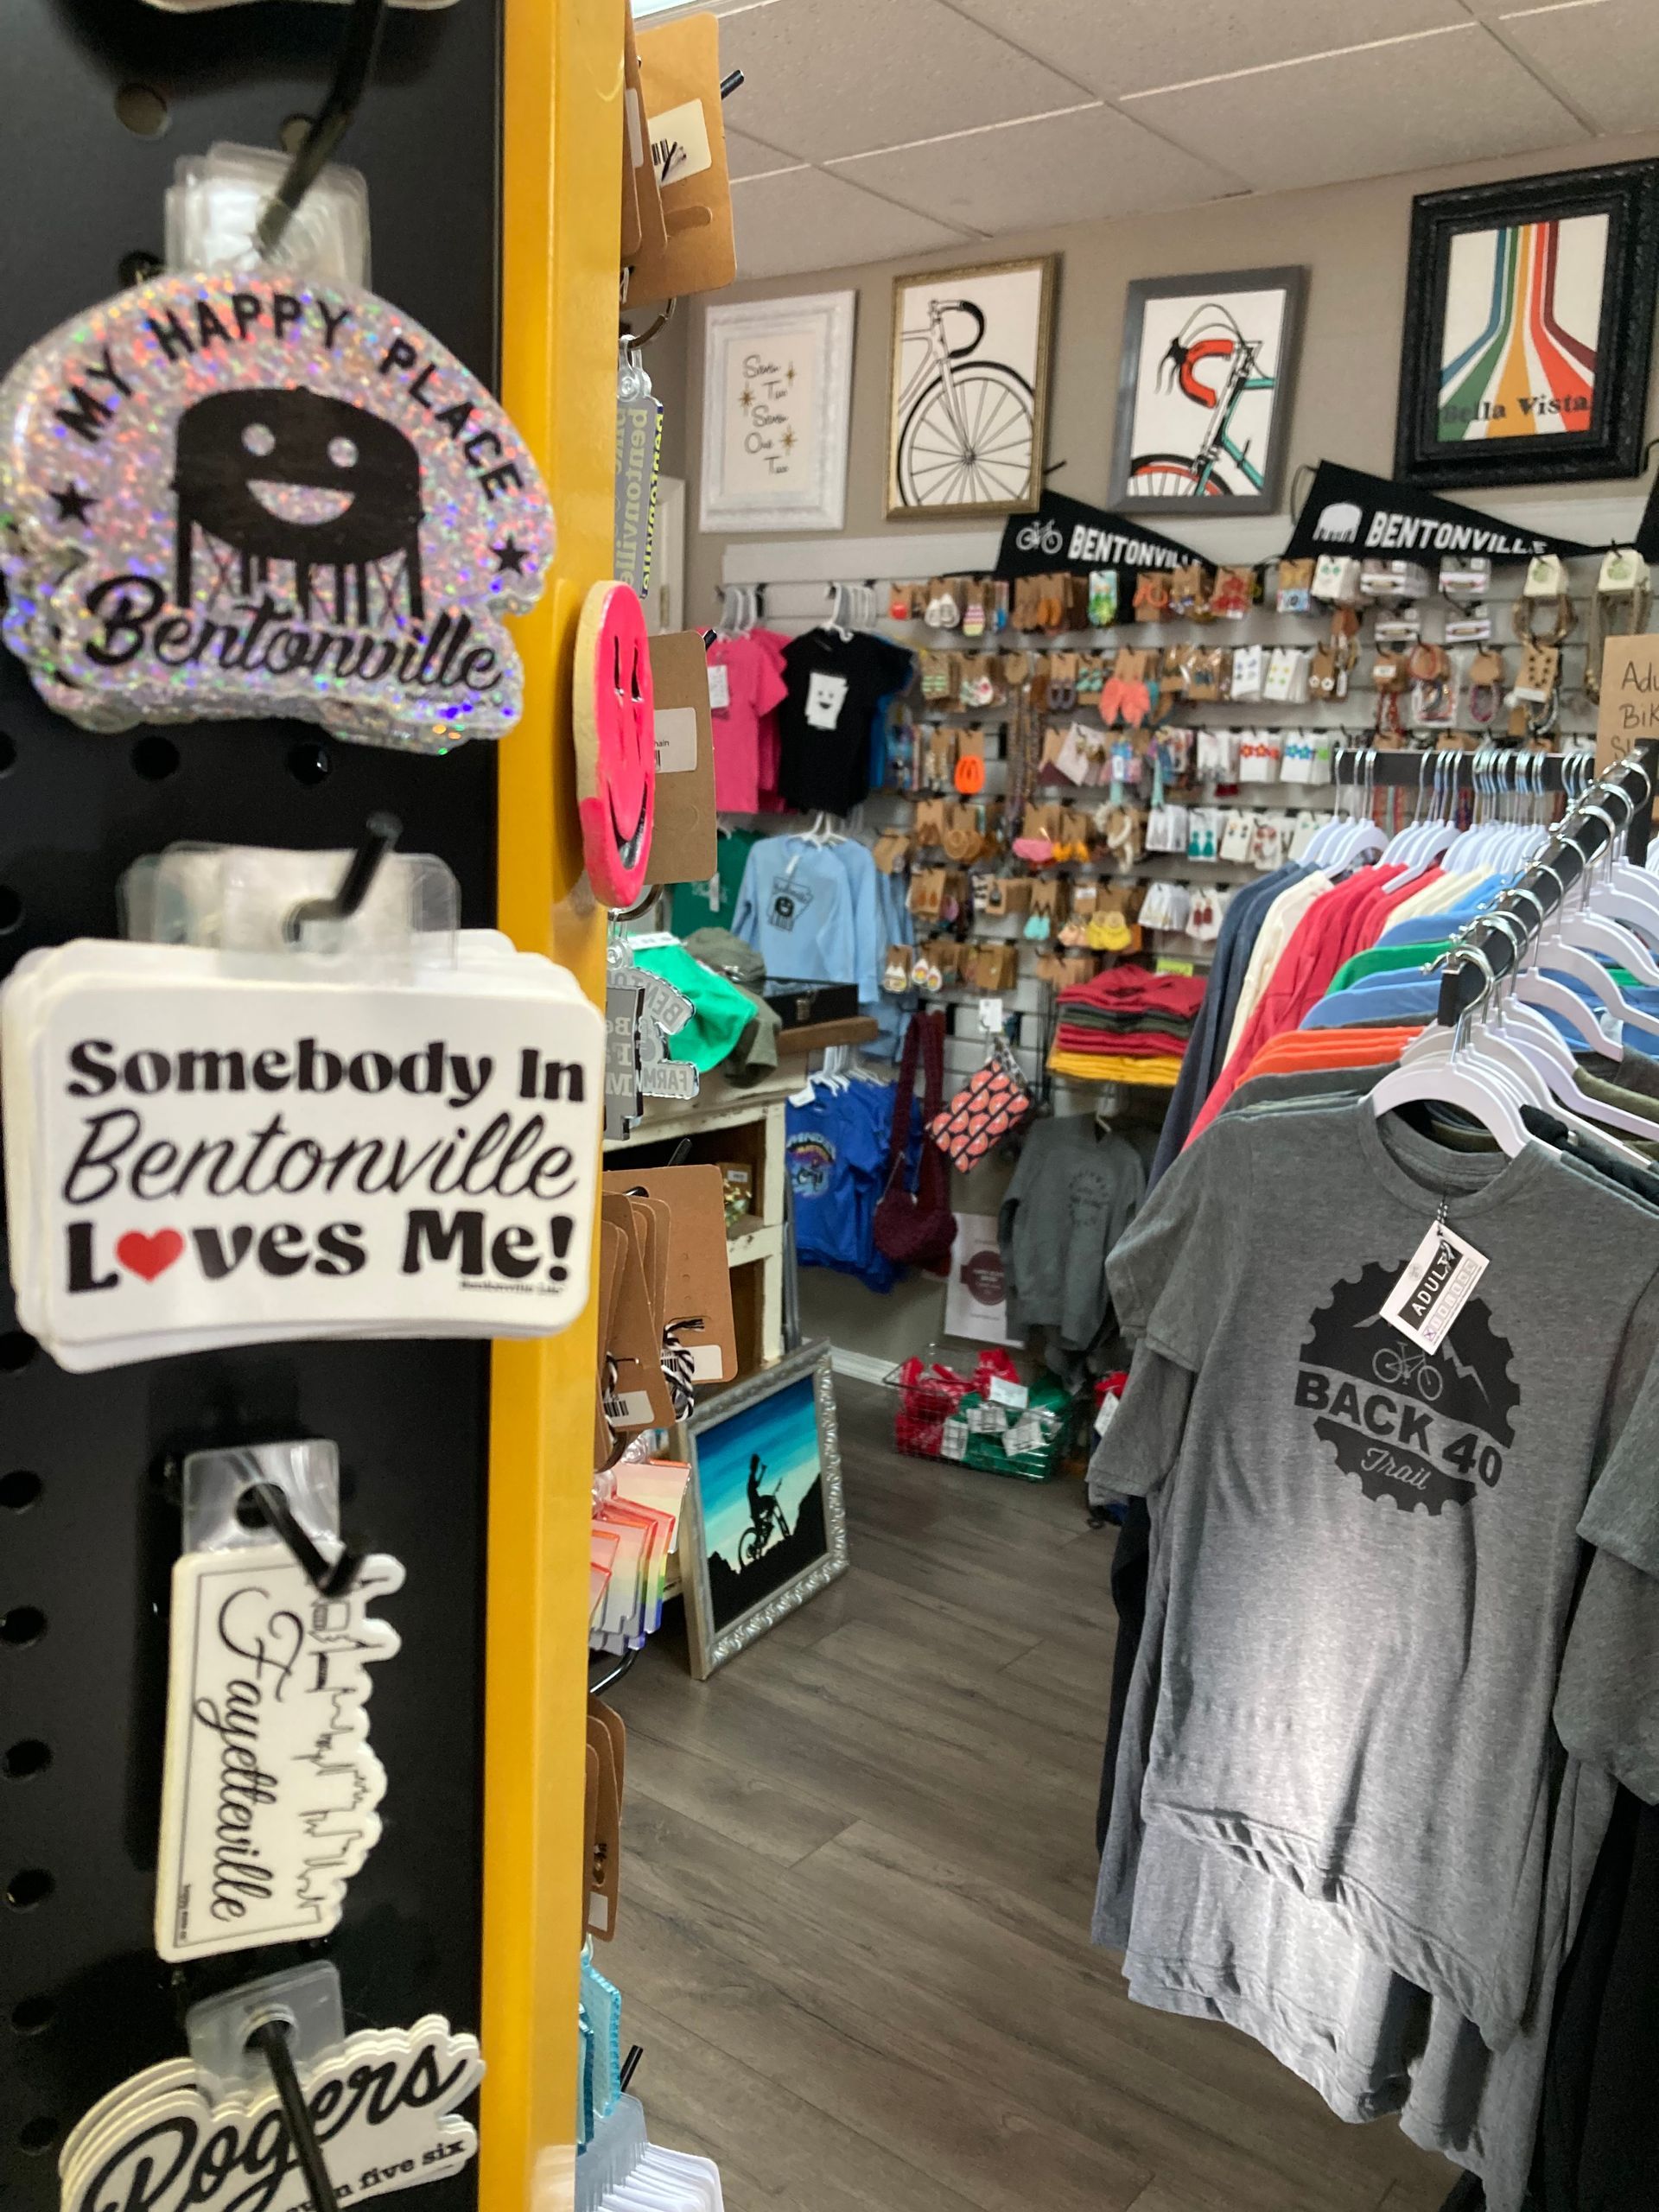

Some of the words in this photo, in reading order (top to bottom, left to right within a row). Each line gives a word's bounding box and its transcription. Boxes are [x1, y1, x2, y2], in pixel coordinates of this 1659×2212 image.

[56, 349, 133, 442] MY
[149, 293, 353, 359] HAPPY
[378, 338, 524, 500] PLACE
[1517, 394, 1590, 415] Vista
[1364, 511, 1548, 555] BENTONVILLE
[85, 574, 504, 690] Bentonville
[67, 1038, 493, 1108] Somebody
[519, 1048, 586, 1102] In
[61, 1109, 578, 1205] Bentonville
[402, 1209, 575, 1281] Me!
[1294, 1370, 1434, 1457] BACK
[1441, 1433, 1503, 1488] 40
[1360, 1447, 1431, 1491] Trail
[194, 1586, 304, 1923] Fayetteville
[78, 2044, 467, 2212] Rogers
[356, 2158, 416, 2190] five
[422, 2139, 465, 2165] six
